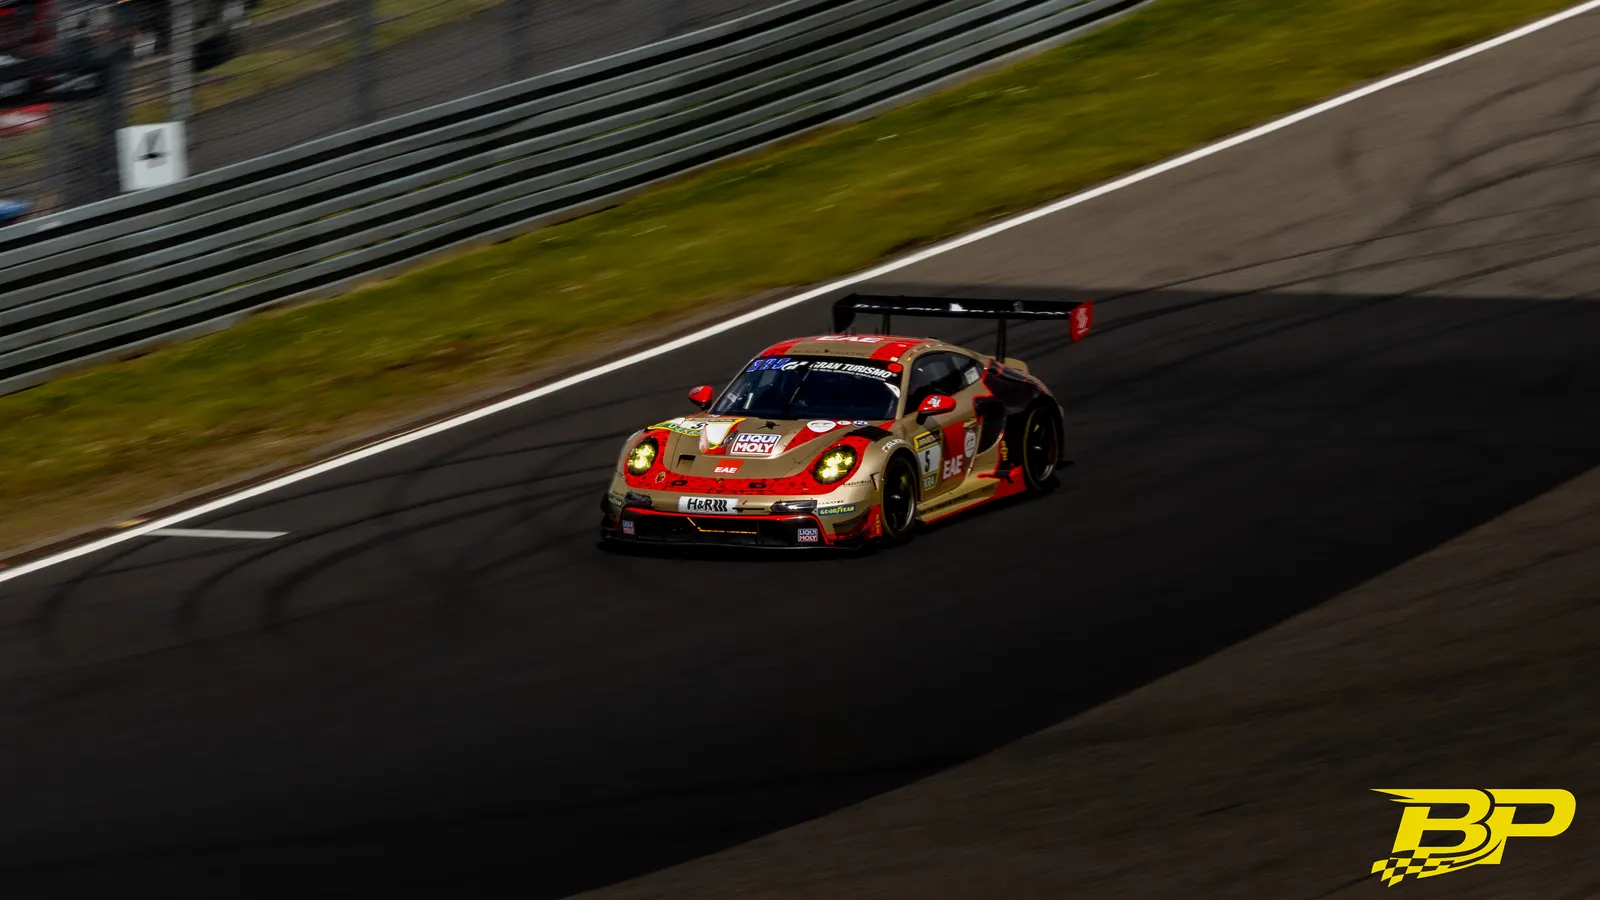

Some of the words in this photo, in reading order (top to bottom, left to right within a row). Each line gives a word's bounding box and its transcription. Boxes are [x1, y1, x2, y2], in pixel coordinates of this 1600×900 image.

[809, 361, 843, 370] GRAN
[738, 434, 777, 443] LIQUI
[733, 443, 774, 453] MOLY
[925, 450, 931, 472] 5
[714, 466, 738, 474] EAE
[943, 454, 963, 480] EAE
[819, 506, 855, 515] GOODYEAR
